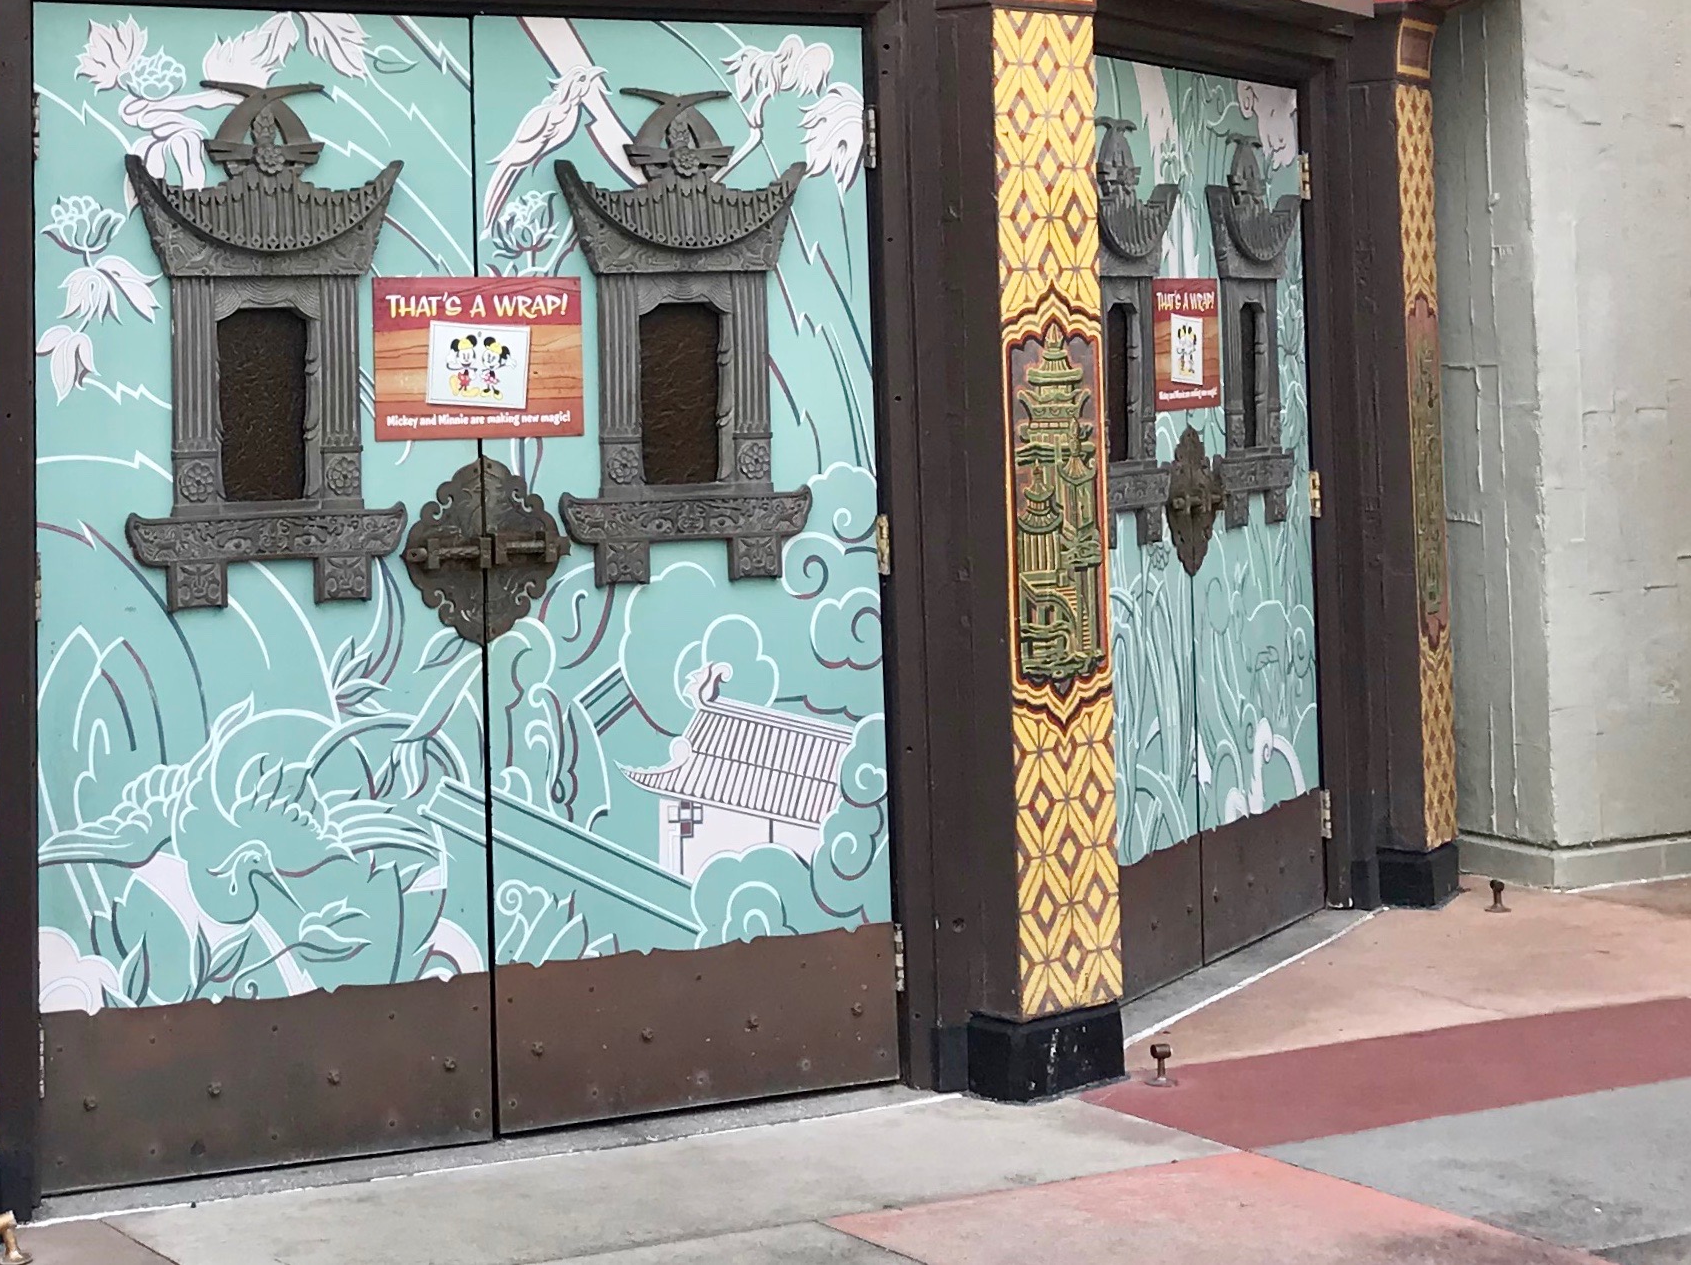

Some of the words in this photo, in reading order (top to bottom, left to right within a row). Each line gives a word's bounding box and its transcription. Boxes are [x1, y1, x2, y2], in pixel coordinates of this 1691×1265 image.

[385, 292, 462, 318] THAT'S
[470, 295, 486, 318] A
[493, 293, 568, 318] WRAP!
[1156, 290, 1181, 312] THAT'S
[1183, 292, 1189, 311] A
[1189, 291, 1215, 312] WRAP!
[386, 414, 418, 429] Mickey
[419, 414, 437, 426] and
[438, 413, 469, 425] Minnie
[470, 416, 485, 425] are
[487, 411, 520, 426] making
[521, 414, 540, 423] new
[540, 410, 571, 426] magic!
